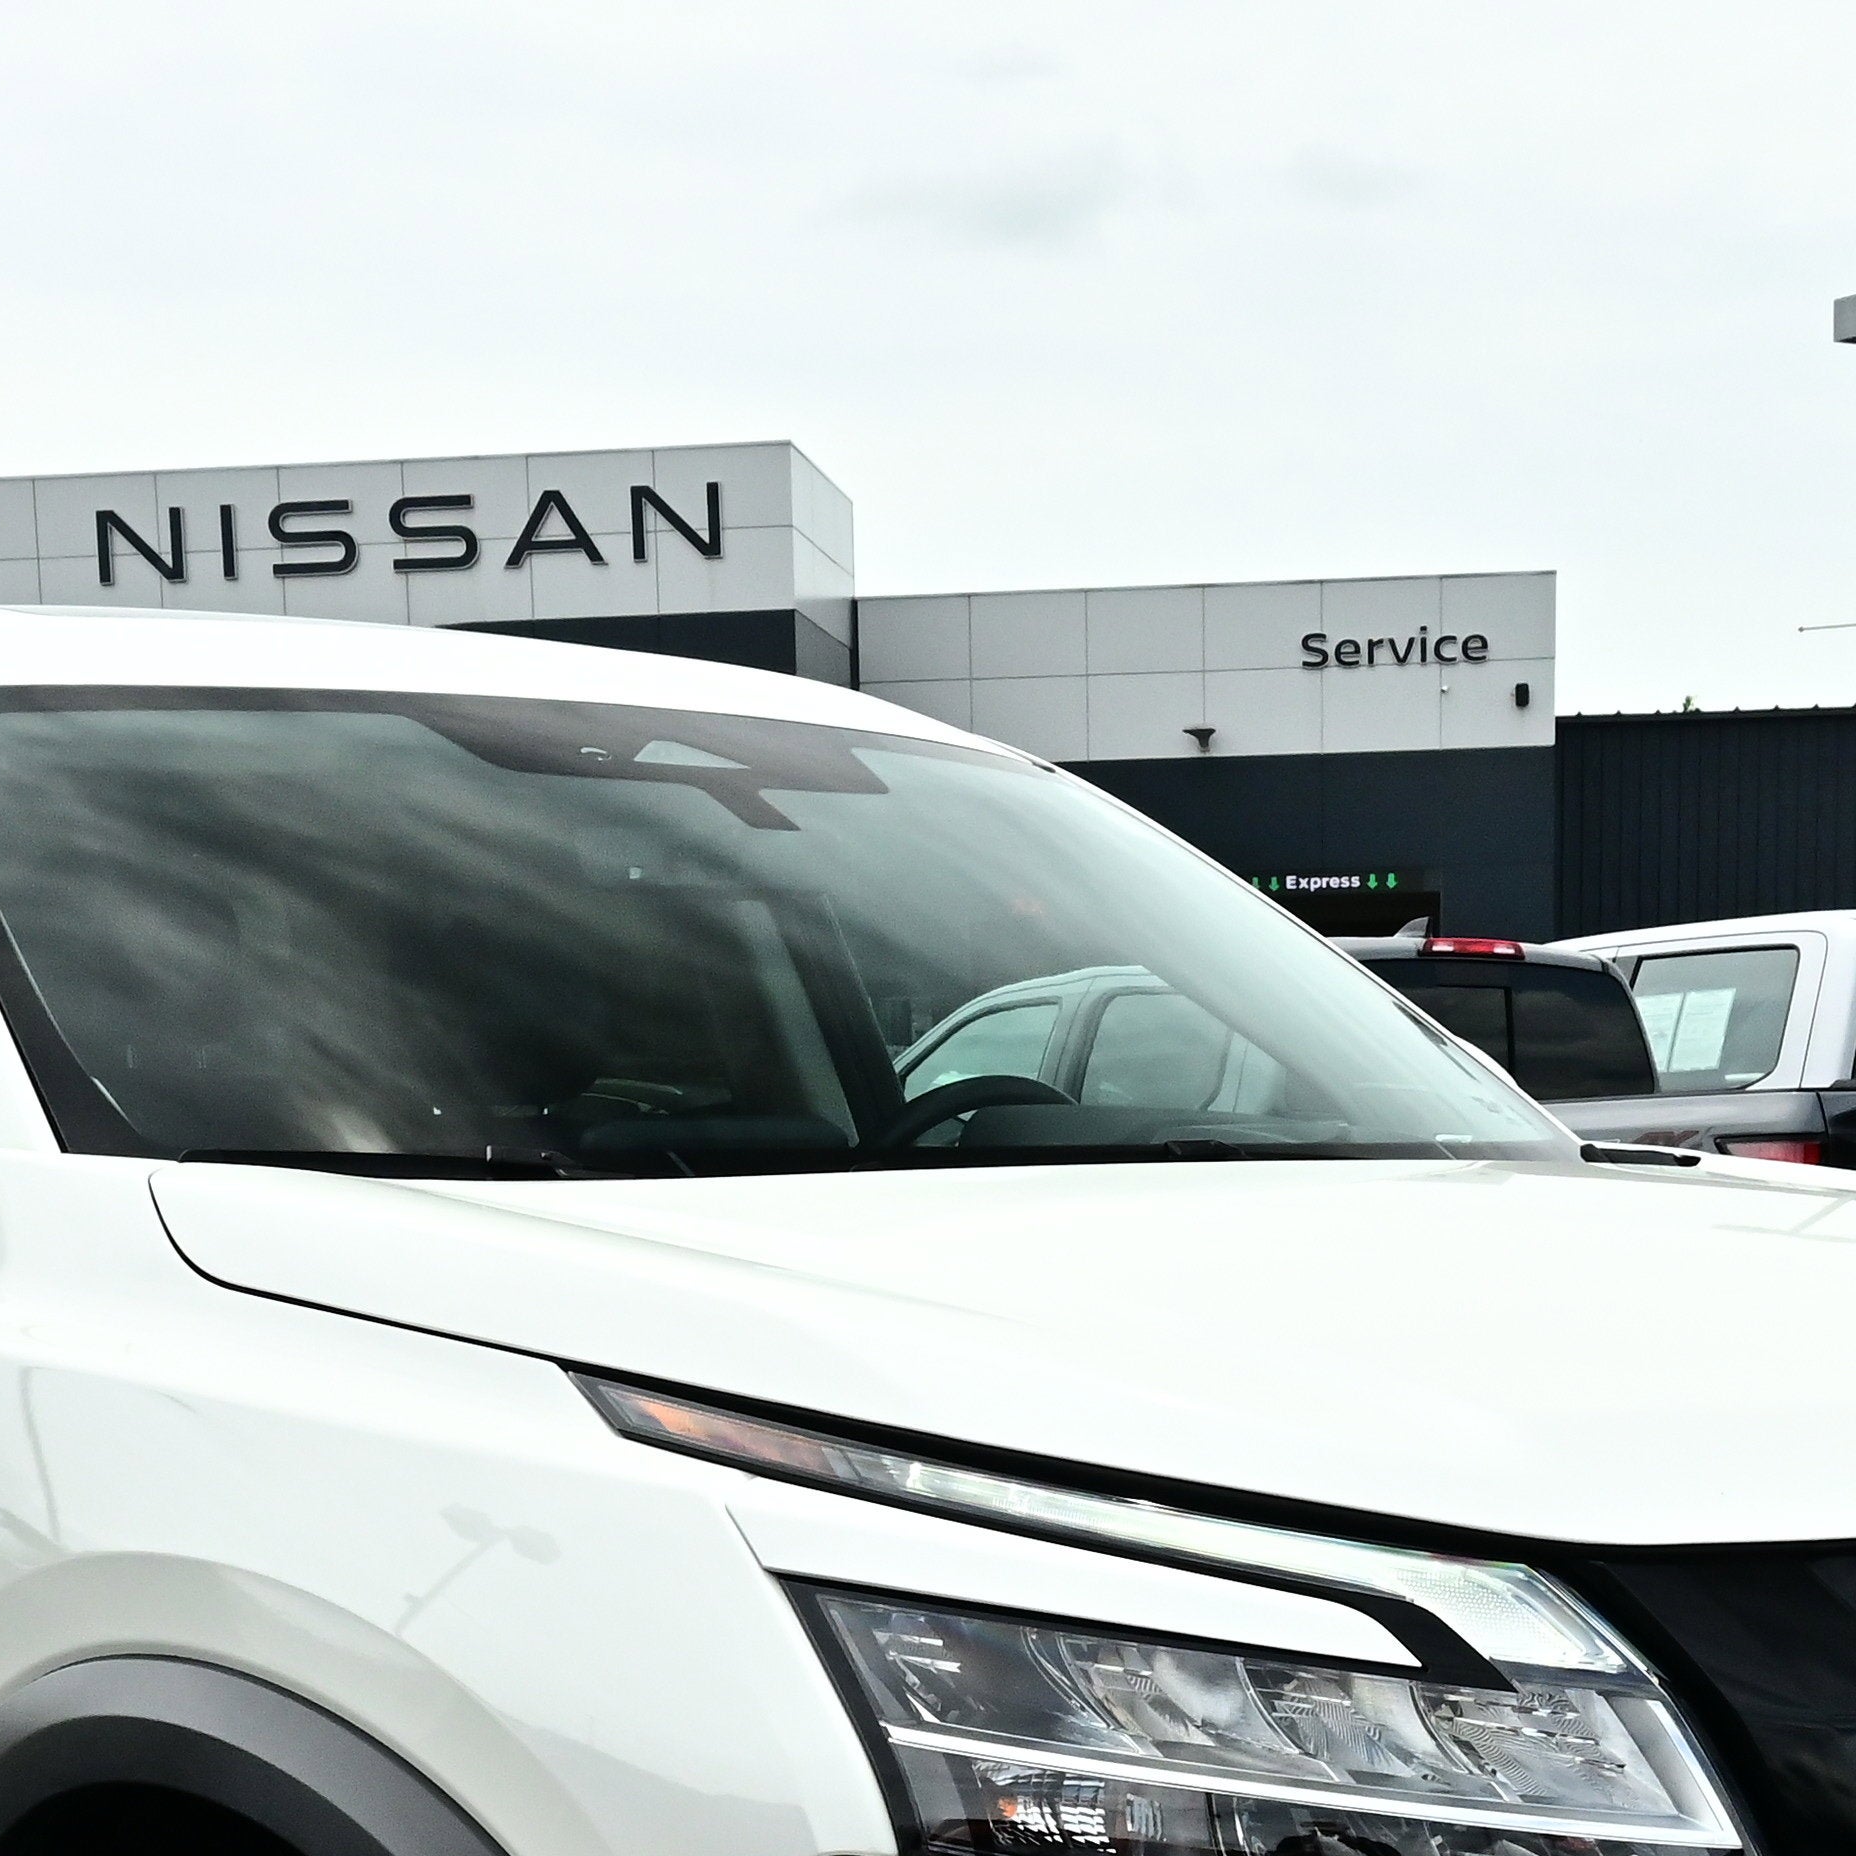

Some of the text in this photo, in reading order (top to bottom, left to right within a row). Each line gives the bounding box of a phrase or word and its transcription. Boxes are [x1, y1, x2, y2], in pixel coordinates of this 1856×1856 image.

[95, 481, 724, 586] NISSAN
[1300, 625, 1490, 668] Service
[1285, 873, 1361, 891] Express
